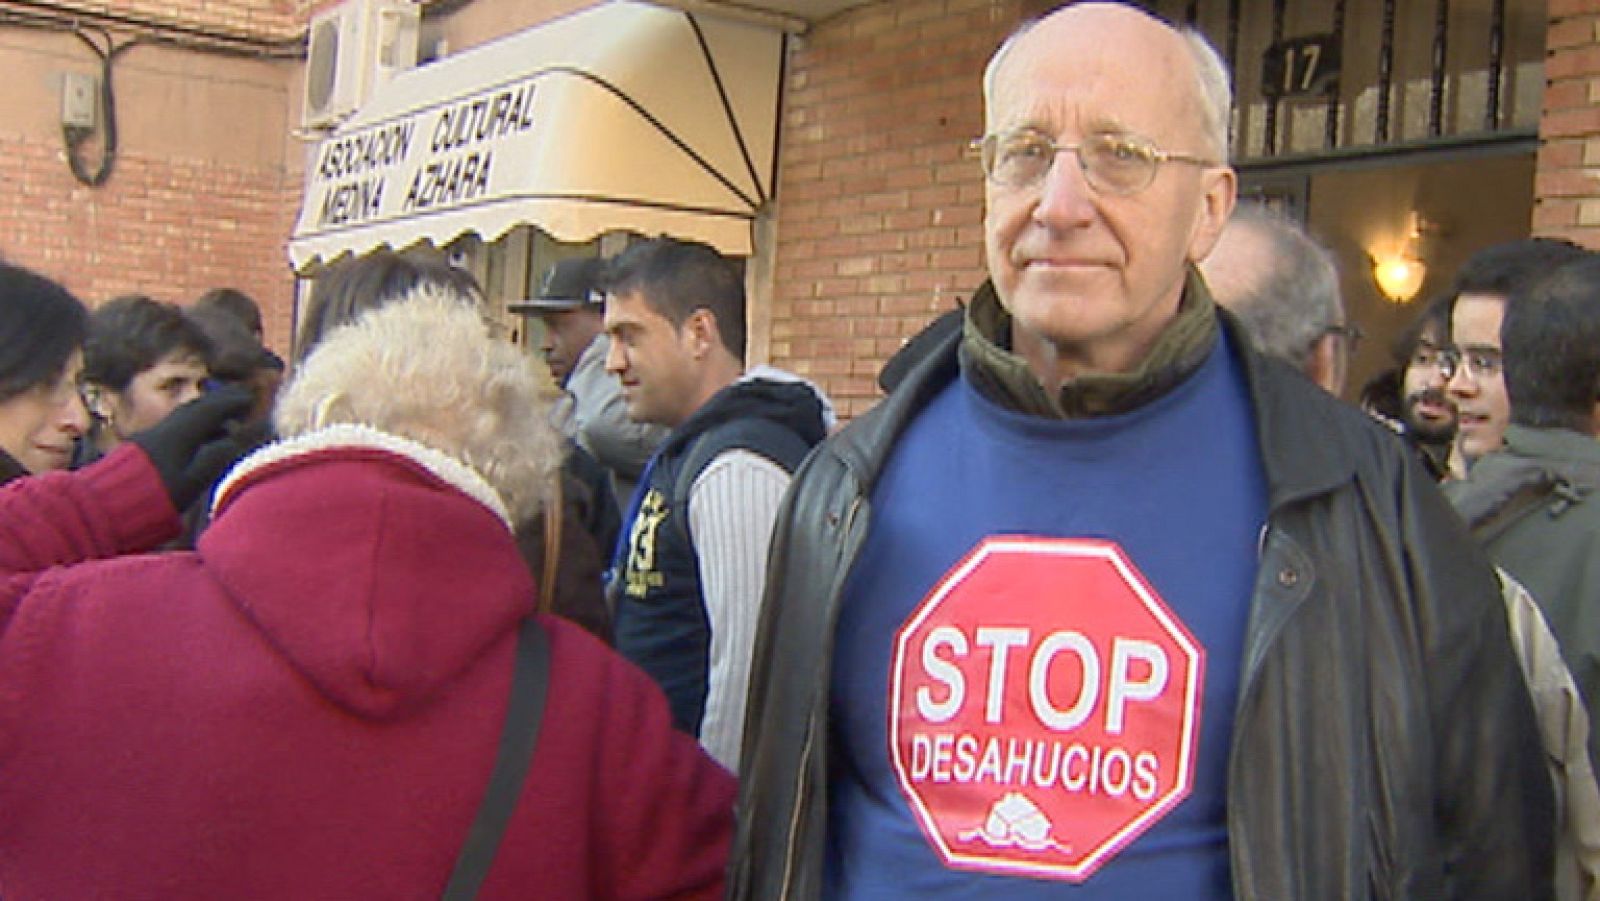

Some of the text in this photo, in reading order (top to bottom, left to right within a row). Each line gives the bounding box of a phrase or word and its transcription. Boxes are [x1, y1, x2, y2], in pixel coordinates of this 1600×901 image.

[1284, 45, 1320, 91] 17
[318, 84, 535, 177] ASOCIACION CULTURAL
[319, 153, 491, 223] MEDINA AZHARA
[916, 626, 1168, 734] STOP
[911, 734, 1158, 798] DESAHUCIOS
